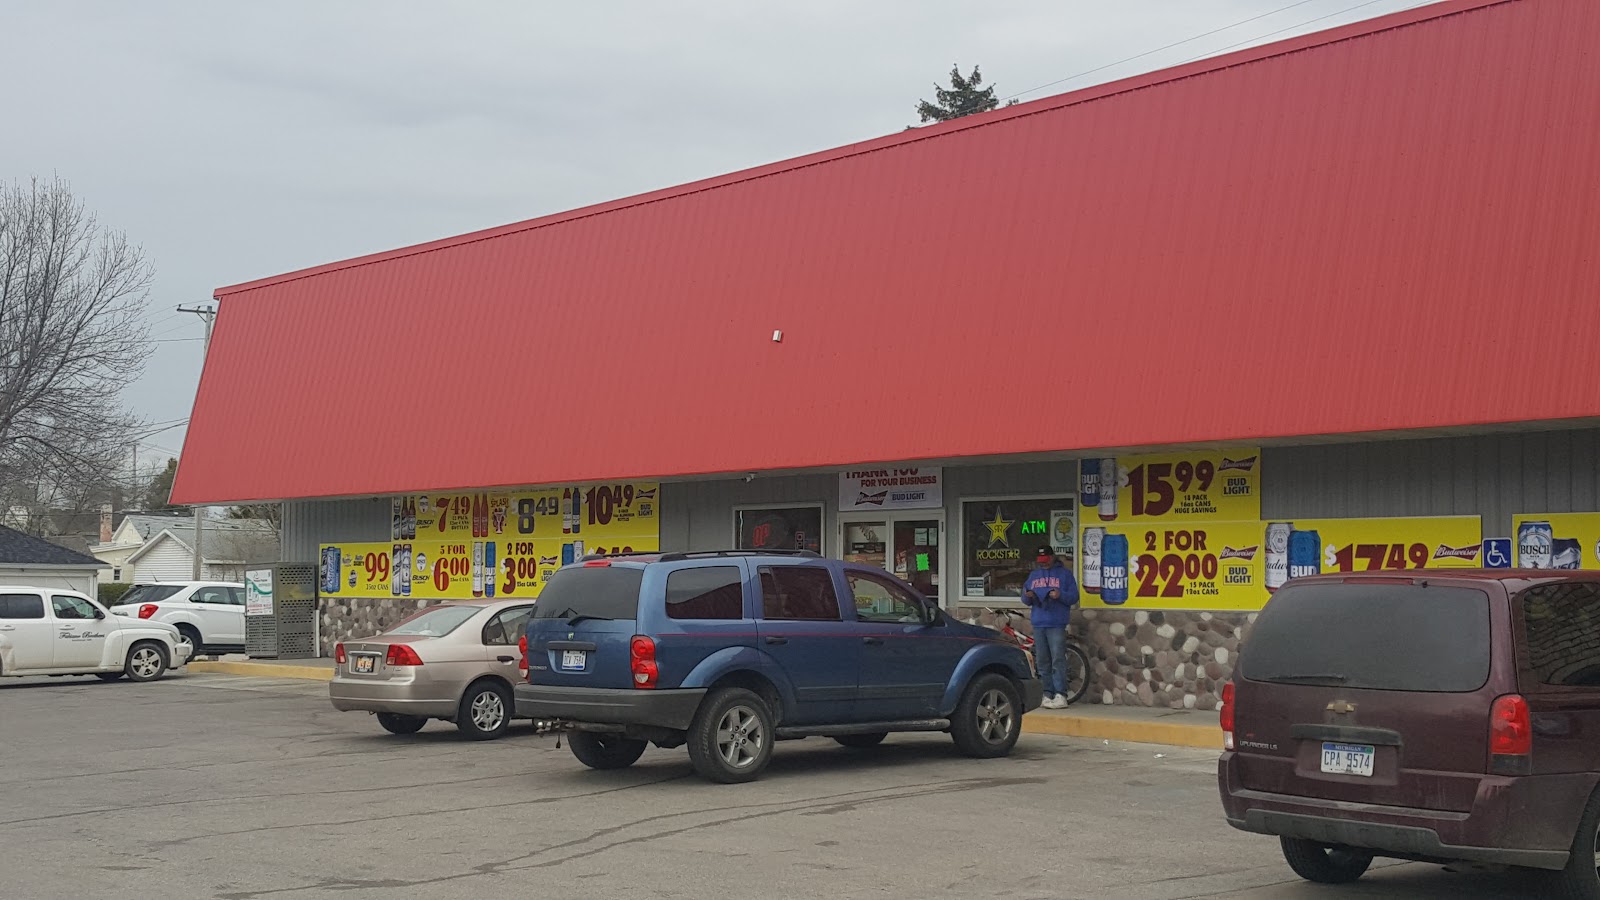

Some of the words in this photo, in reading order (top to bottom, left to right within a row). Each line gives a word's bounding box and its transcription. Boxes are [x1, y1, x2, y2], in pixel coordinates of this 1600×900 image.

[860, 479, 877, 488] FOR
[878, 478, 899, 487] YOUR
[900, 475, 937, 486] BUSINESS
[1081, 474, 1100, 485] BUD
[1227, 478, 1247, 487] BUD
[1223, 486, 1251, 495] LIGHT
[891, 493, 906, 501] BUD
[907, 492, 925, 501] LIGHT
[1021, 520, 1047, 534] ATM
[1145, 531, 1157, 551] 2
[1164, 530, 1208, 551] FOR
[440, 545, 446, 555] 5
[447, 544, 466, 555] FOR
[507, 542, 513, 555] 2
[515, 541, 534, 555] FOR
[1222, 548, 1255, 557] Budweiser
[1437, 547, 1478, 556] Budweiser
[1520, 544, 1550, 555] BUSCH
[1103, 566, 1126, 578] BUD
[1228, 567, 1248, 575] BUD
[1224, 575, 1252, 584] LIGHT
[1323, 751, 1341, 766] CPA
[1346, 752, 1370, 769] 9574
